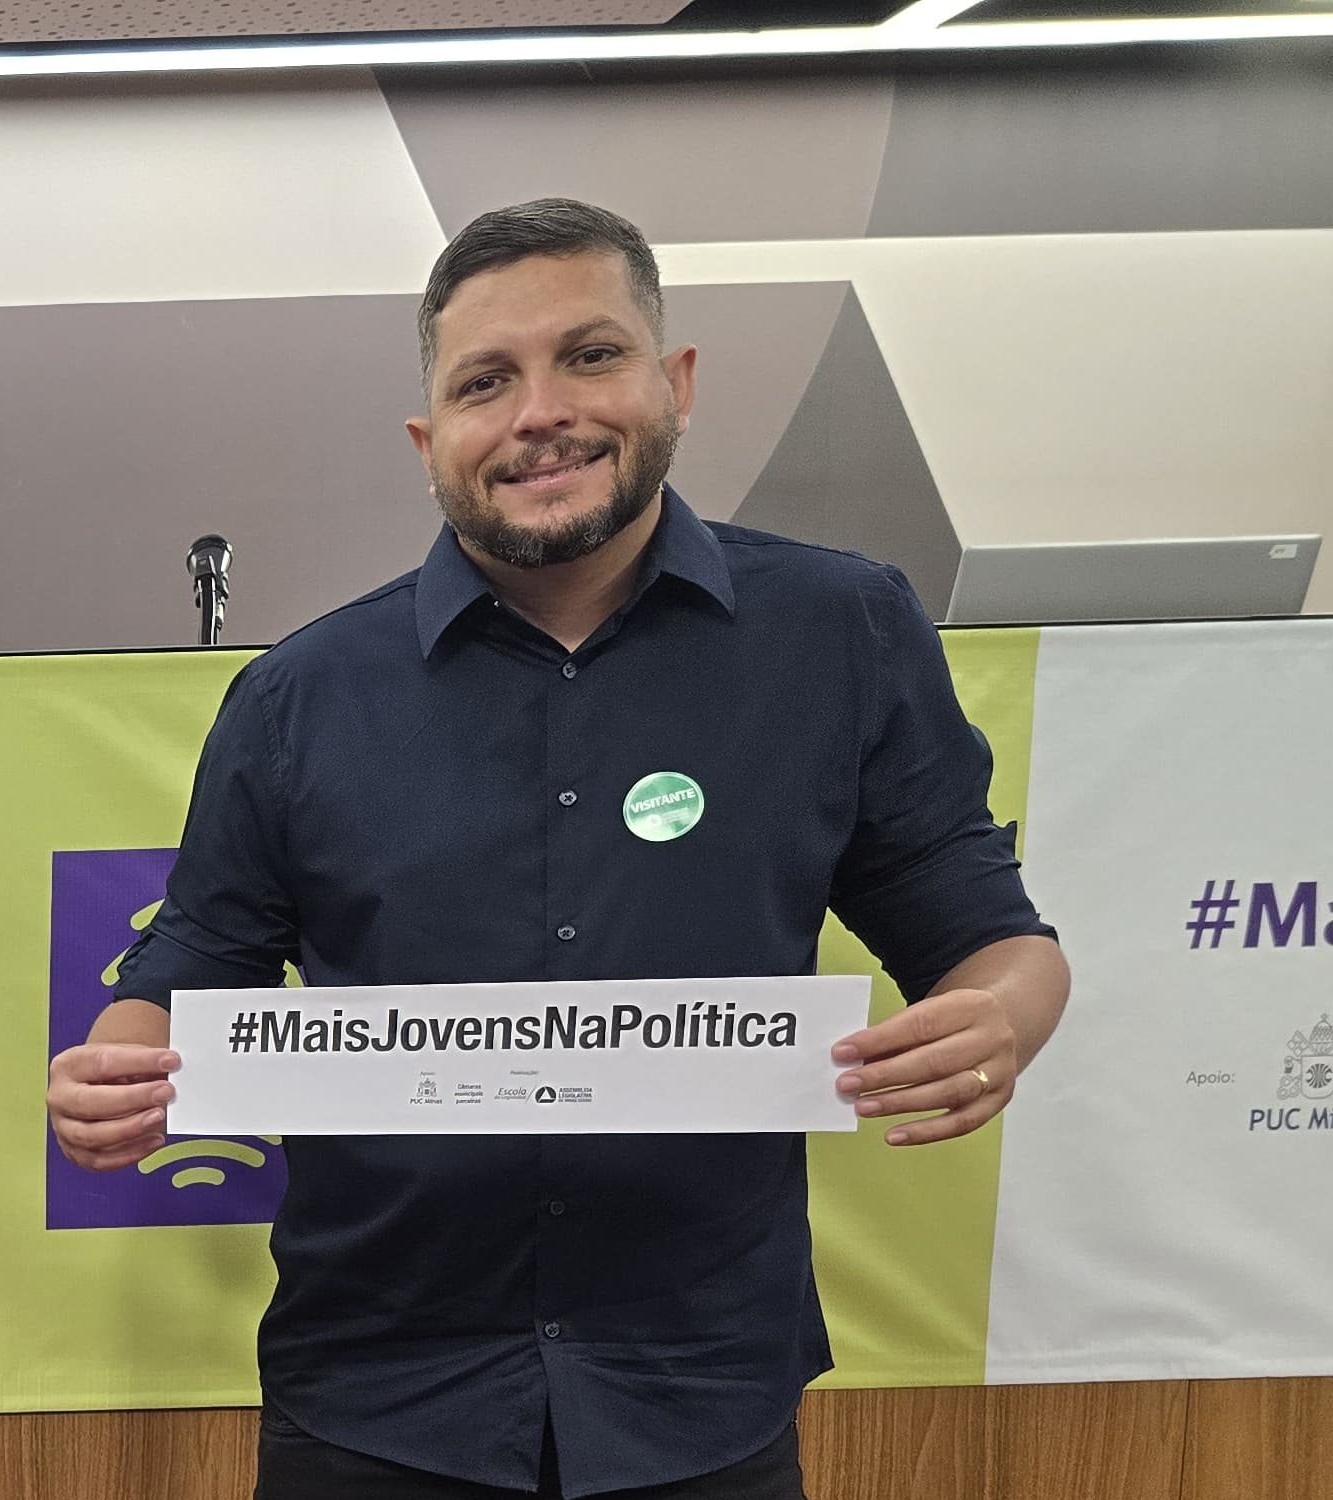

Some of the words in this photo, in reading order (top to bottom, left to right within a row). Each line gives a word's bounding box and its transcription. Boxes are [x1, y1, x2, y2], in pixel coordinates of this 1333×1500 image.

[629, 787, 696, 813] VISITANTE
[1185, 879, 1333, 949] #M
[229, 1001, 797, 1053] #MaisJovensNaPolítica
[1185, 1070, 1235, 1087] Apoio:
[1249, 1108, 1301, 1131] PUC
